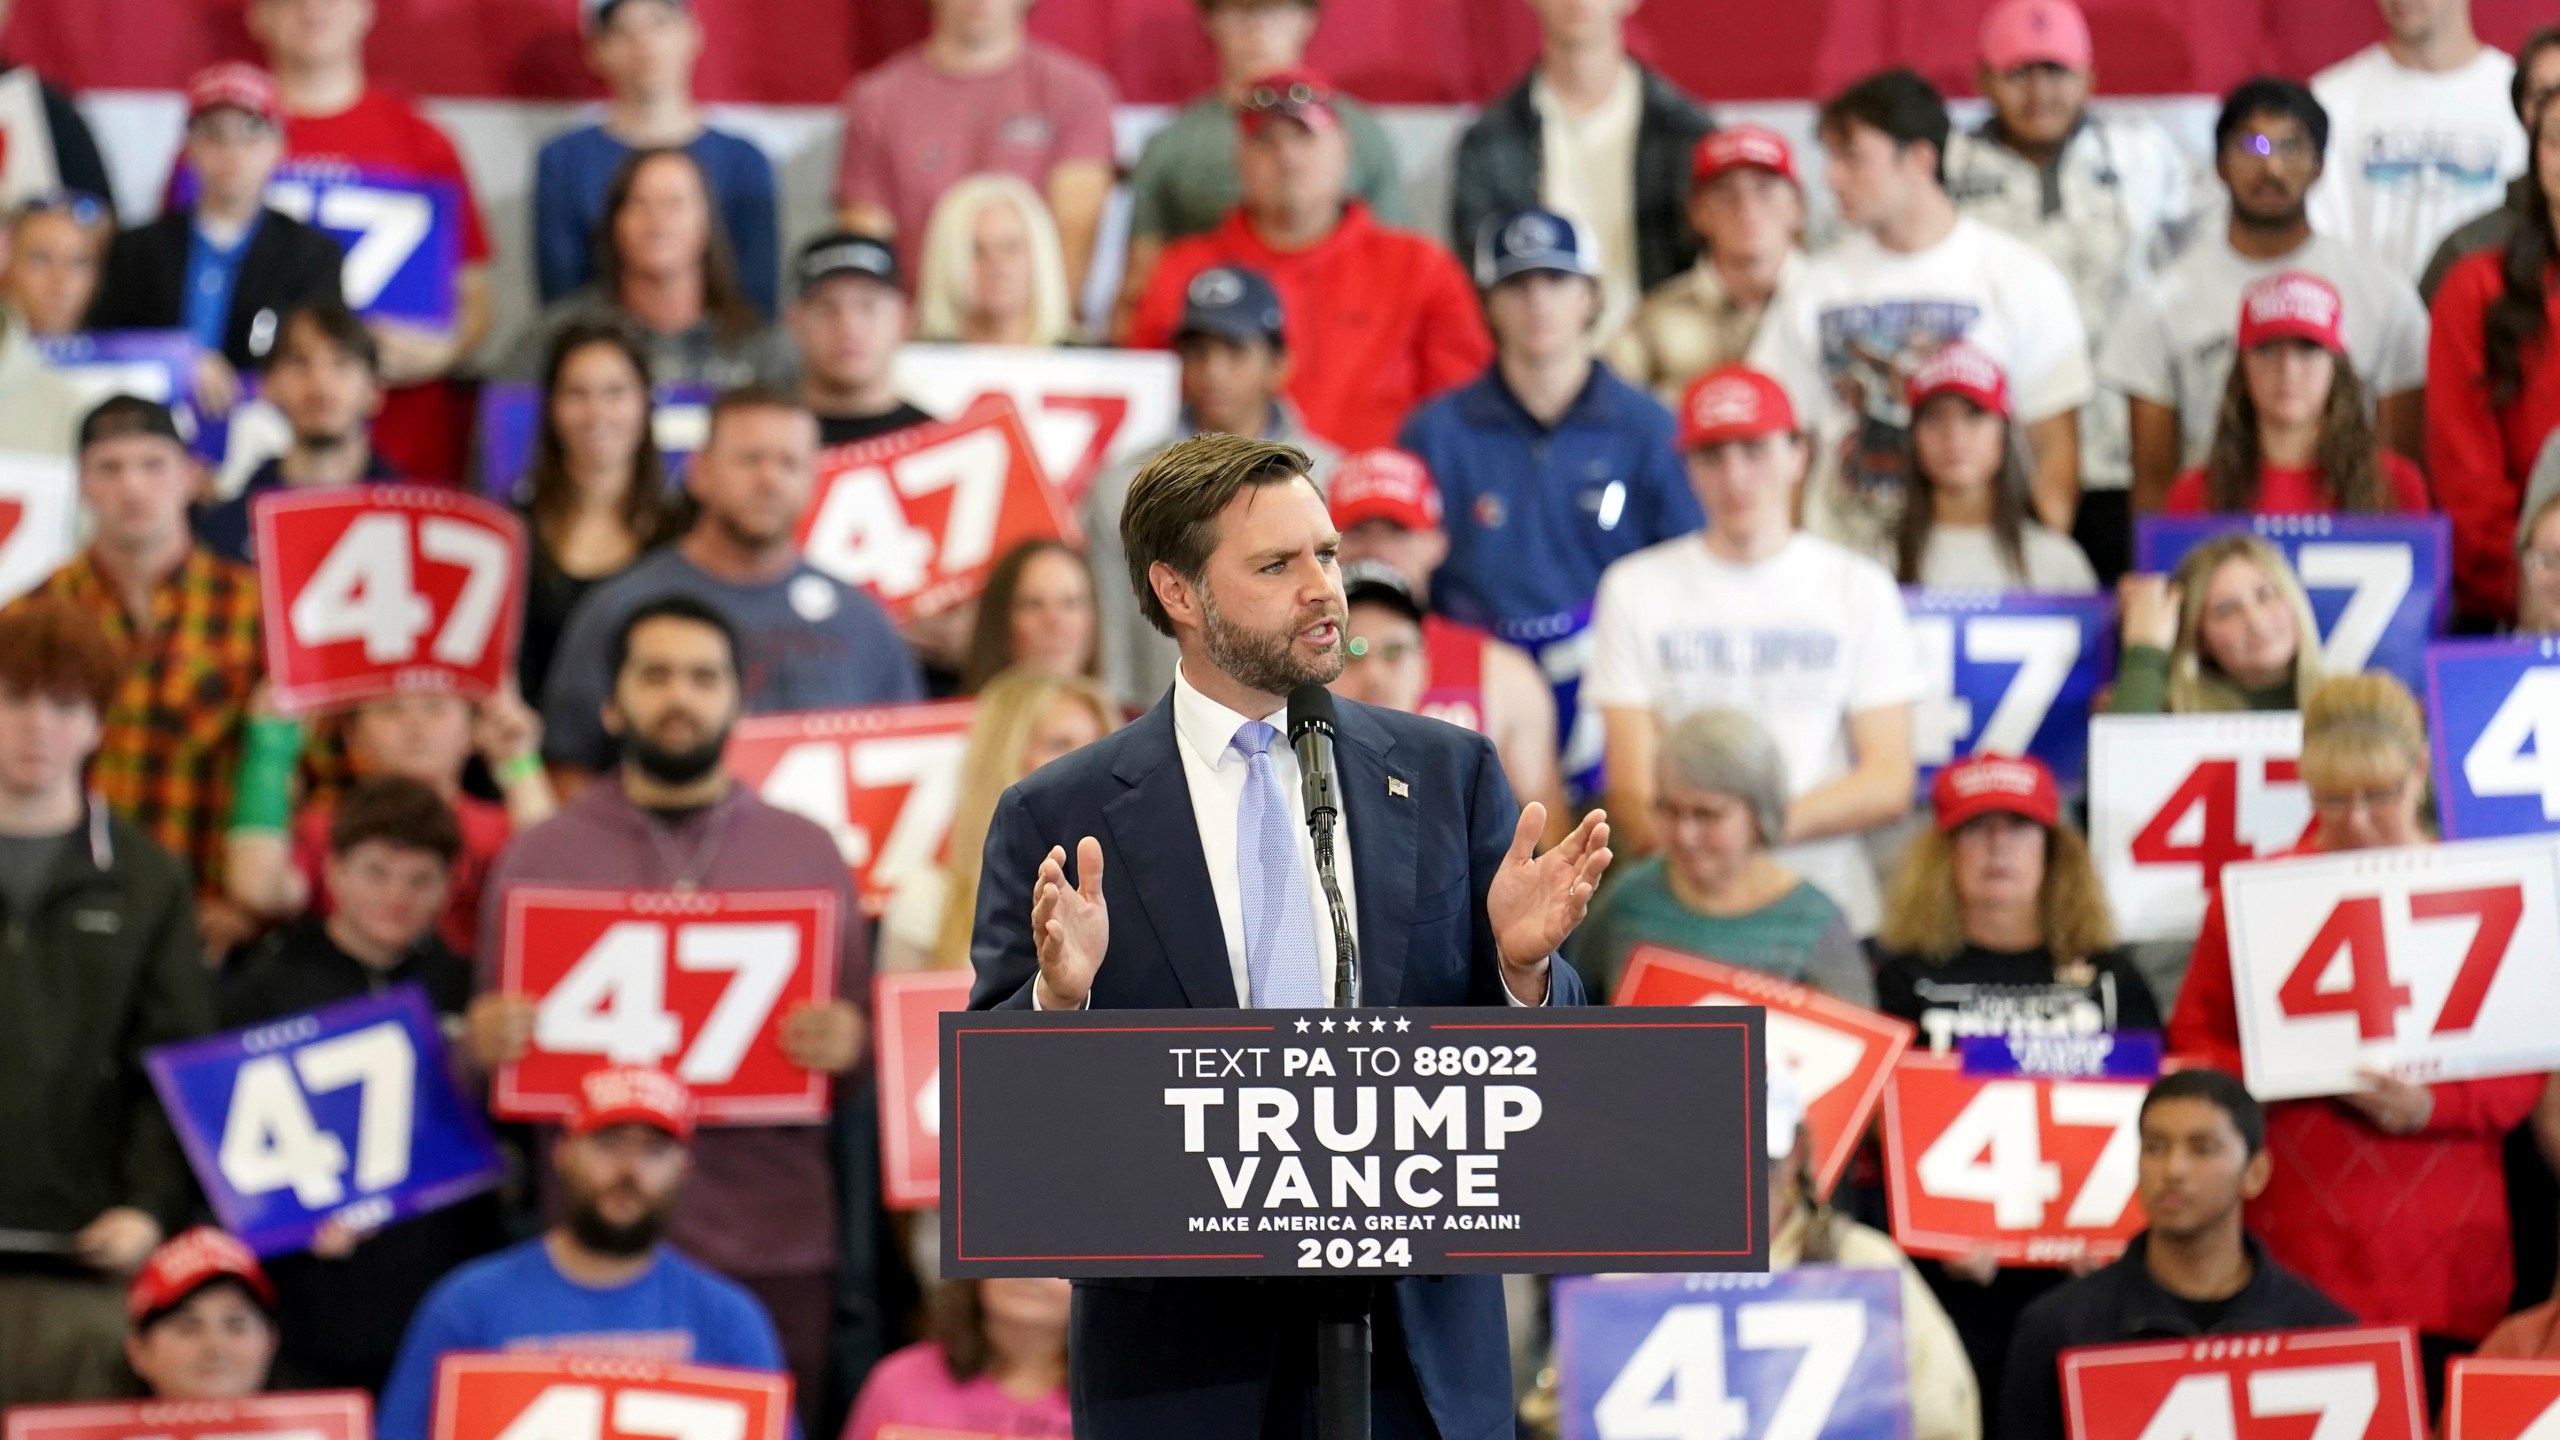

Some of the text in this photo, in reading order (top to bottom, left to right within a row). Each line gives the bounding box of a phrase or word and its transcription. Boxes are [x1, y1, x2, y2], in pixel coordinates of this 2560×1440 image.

[803, 422, 1011, 597] 47
[289, 512, 511, 667] 47
[532, 920, 802, 1084] 47
[2277, 883, 2524, 1041] 47
[217, 1021, 417, 1210] 47
[1164, 1085, 1543, 1153] TRUMP
[1169, 1045, 1538, 1078] TEXT PA TO 88022
[1188, 1214, 1521, 1232] MAKE AMERICA GREAT AGAIN!
[1207, 1154, 1500, 1209] VANCE
[1917, 1080, 2149, 1230] 47
[1297, 1237, 1413, 1268] 2024
[1594, 1302, 1867, 1440] 47
